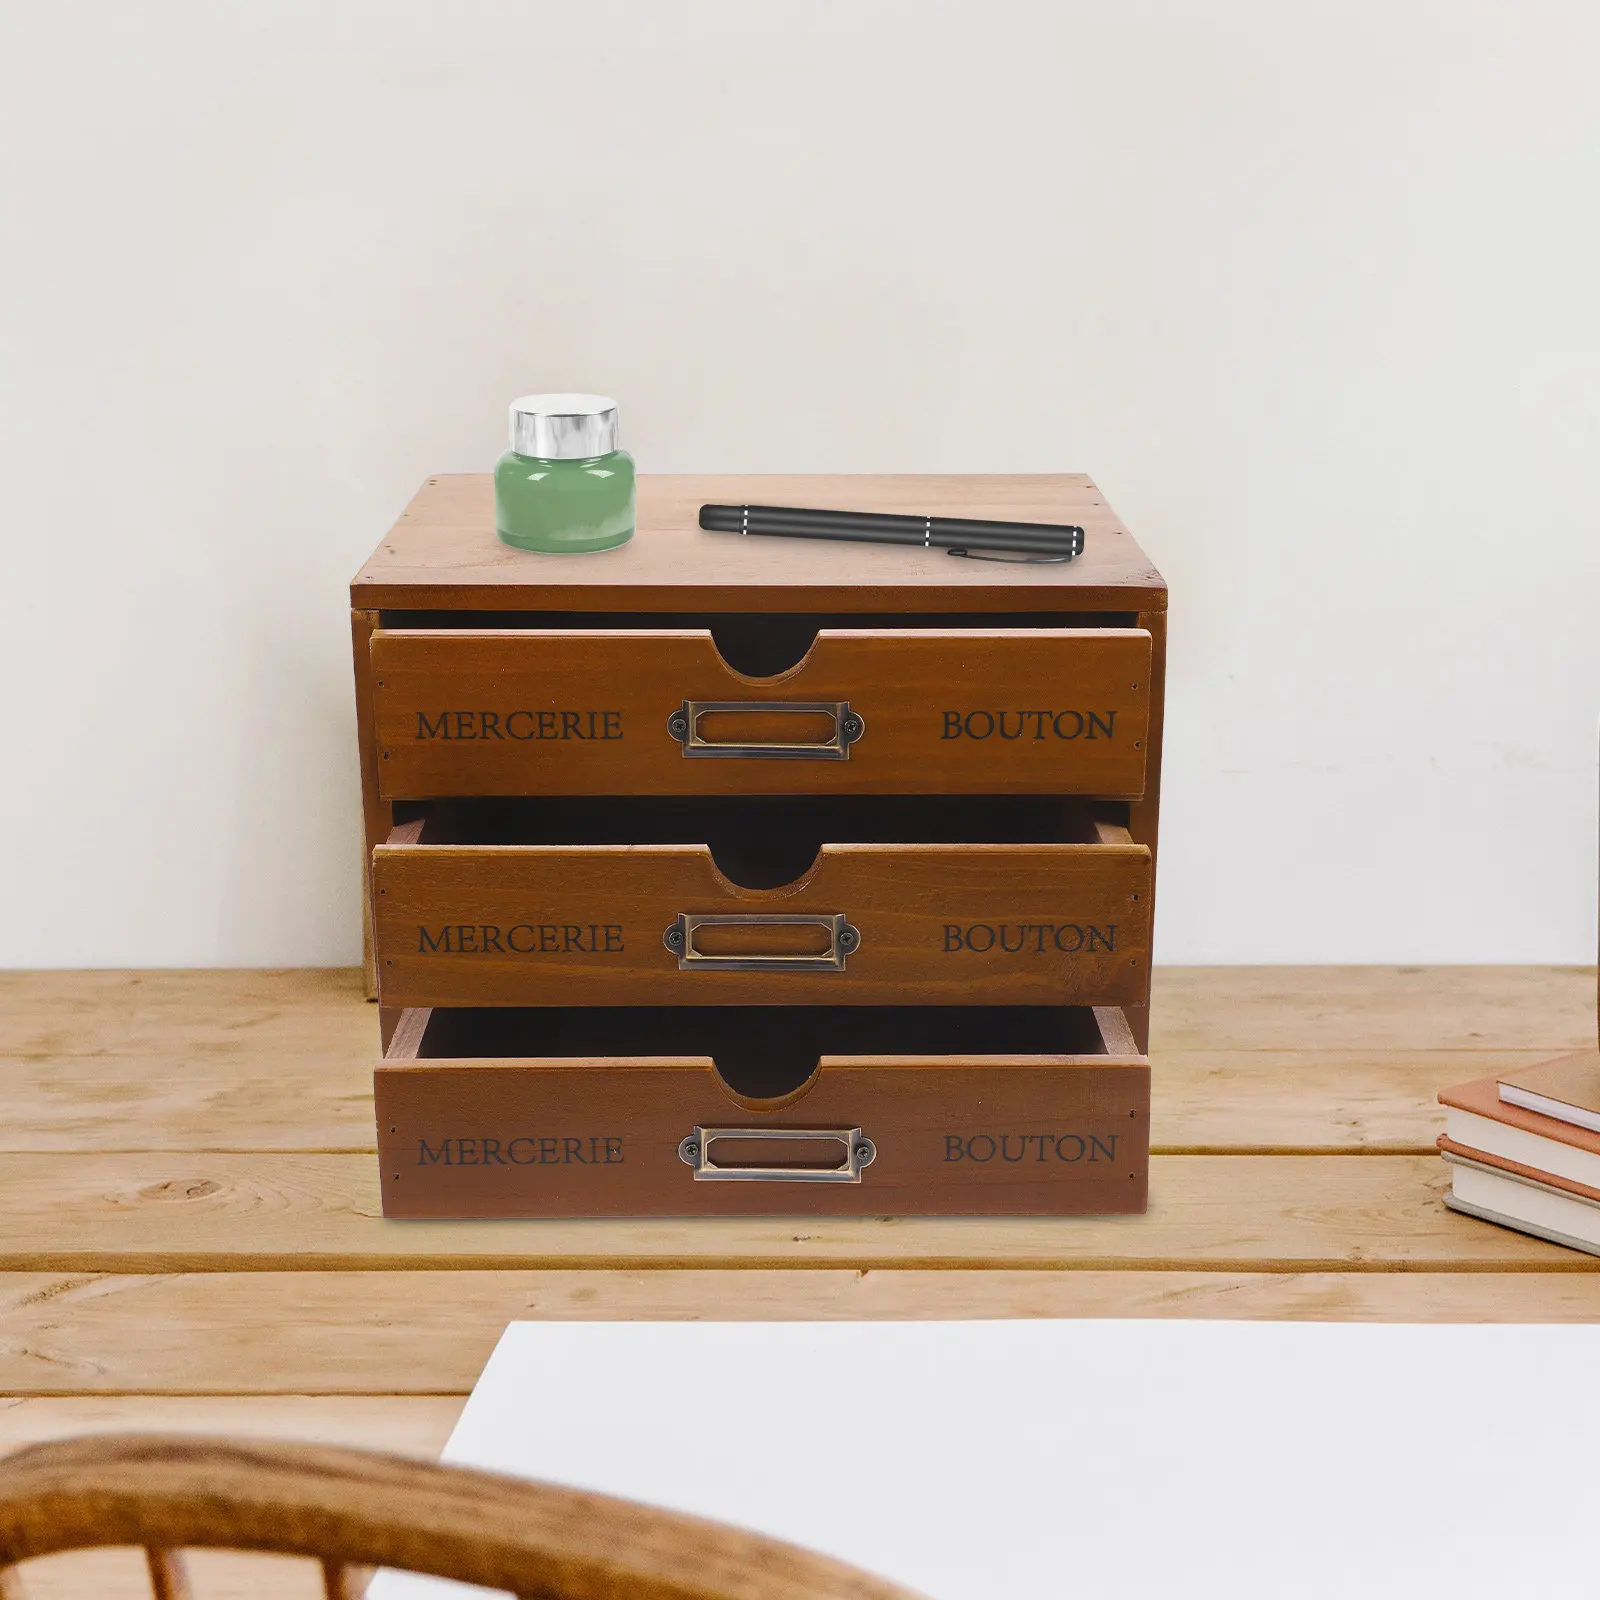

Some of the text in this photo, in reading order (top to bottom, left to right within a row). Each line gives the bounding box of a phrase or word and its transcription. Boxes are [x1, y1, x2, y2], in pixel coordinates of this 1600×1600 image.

[415, 711, 624, 740] MERCERIE
[941, 711, 1116, 740] BOUTON
[418, 925, 625, 953] MERCERIE
[943, 924, 1117, 953] BOUTON
[418, 1138, 625, 1166] MERCERIE
[944, 1135, 1118, 1163] BOUTON
